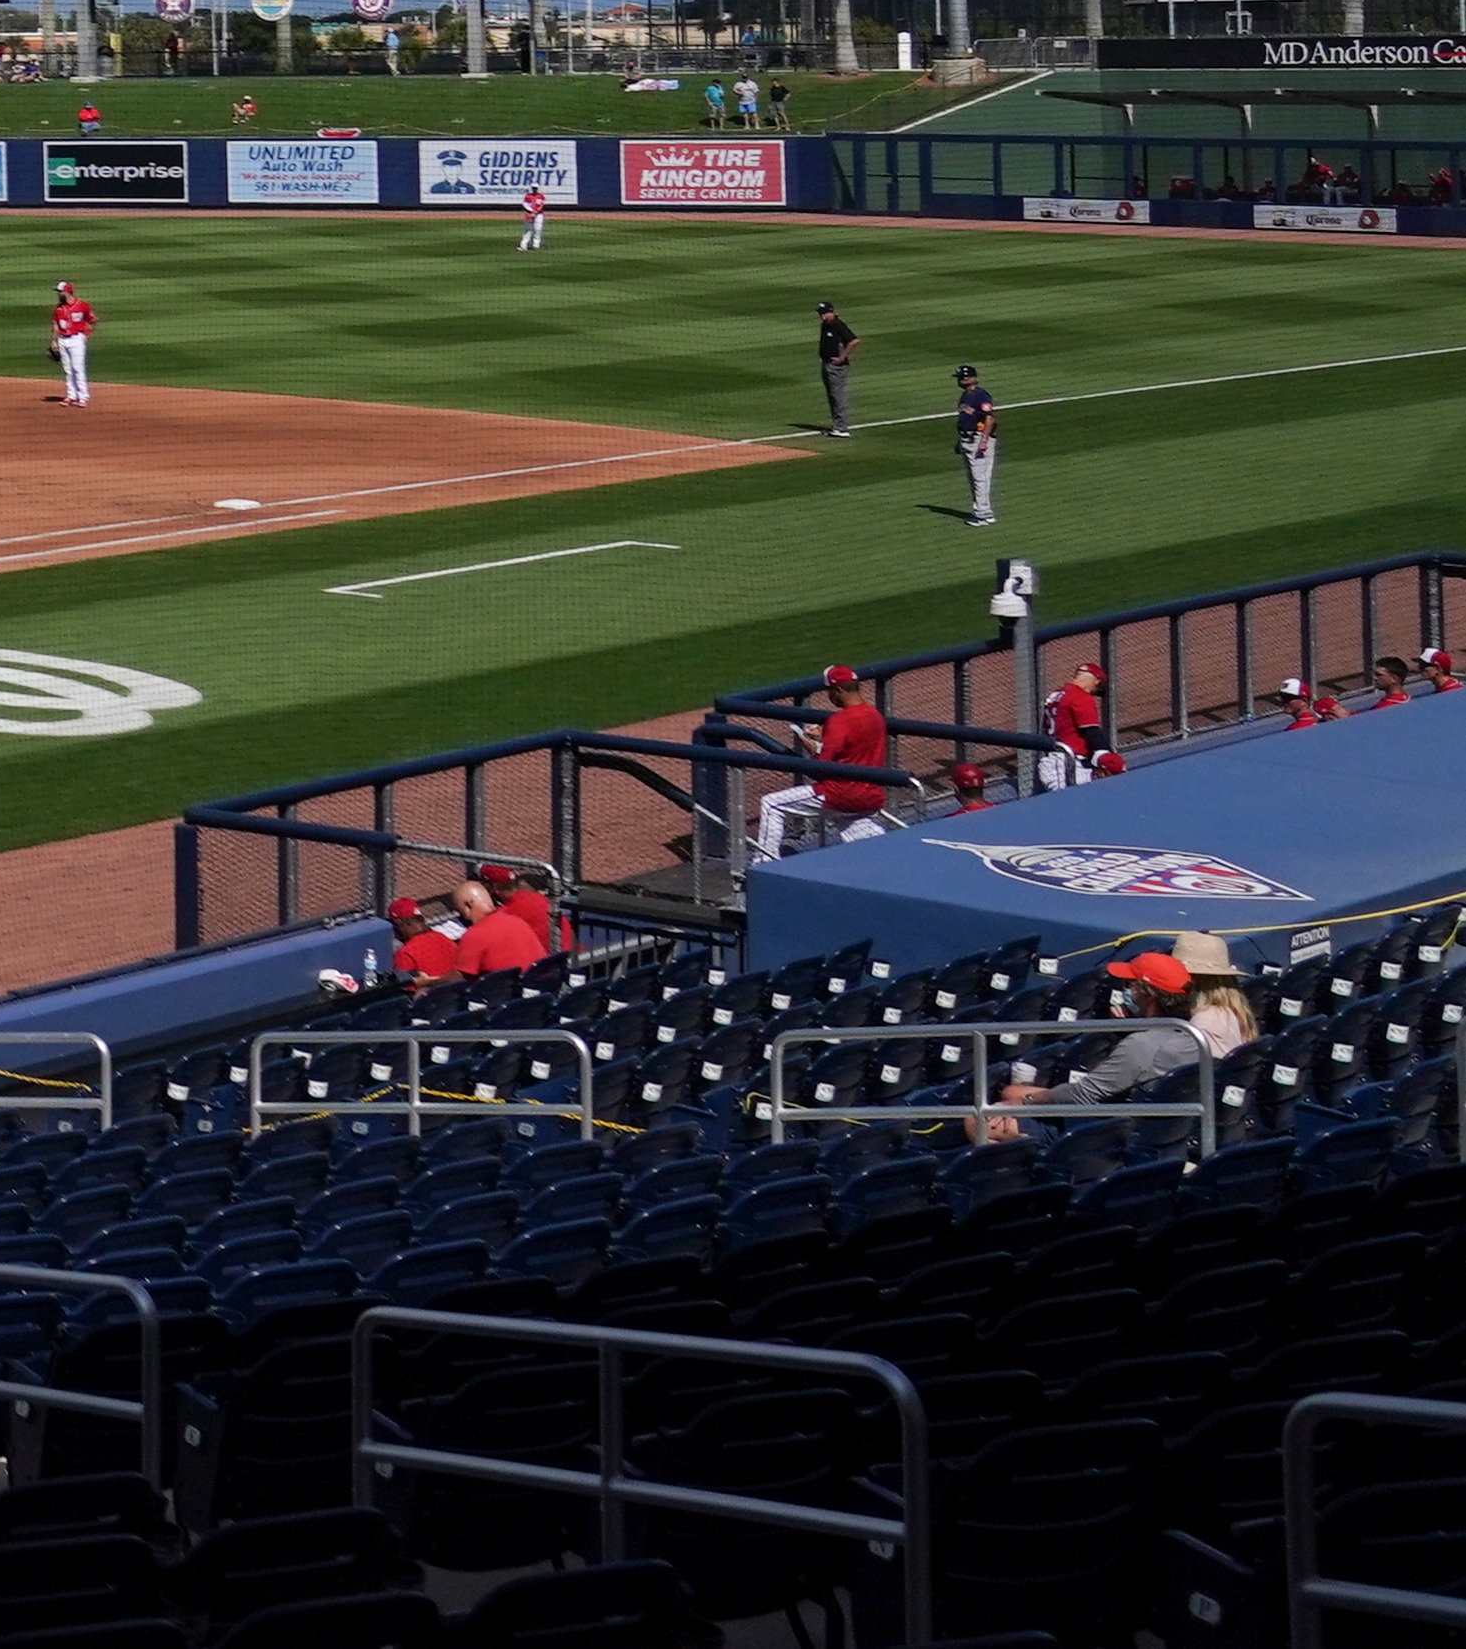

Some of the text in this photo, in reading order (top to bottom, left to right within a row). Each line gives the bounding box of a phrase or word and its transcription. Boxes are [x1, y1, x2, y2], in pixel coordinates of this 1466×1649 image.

[1263, 41, 1308, 65] MD
[1309, 40, 1430, 65] Anderson
[248, 145, 355, 160] UNLIMITED
[479, 151, 559, 168] GIDDENS
[702, 148, 762, 166] TIRE
[52, 162, 184, 182] enterprise
[260, 159, 343, 171] Auto Wash
[478, 170, 568, 186] SECURITY
[639, 169, 766, 188] KINGDOM
[639, 188, 763, 199] SERVICE CENTERS
[1290, 926, 1331, 949] ATTENTION
